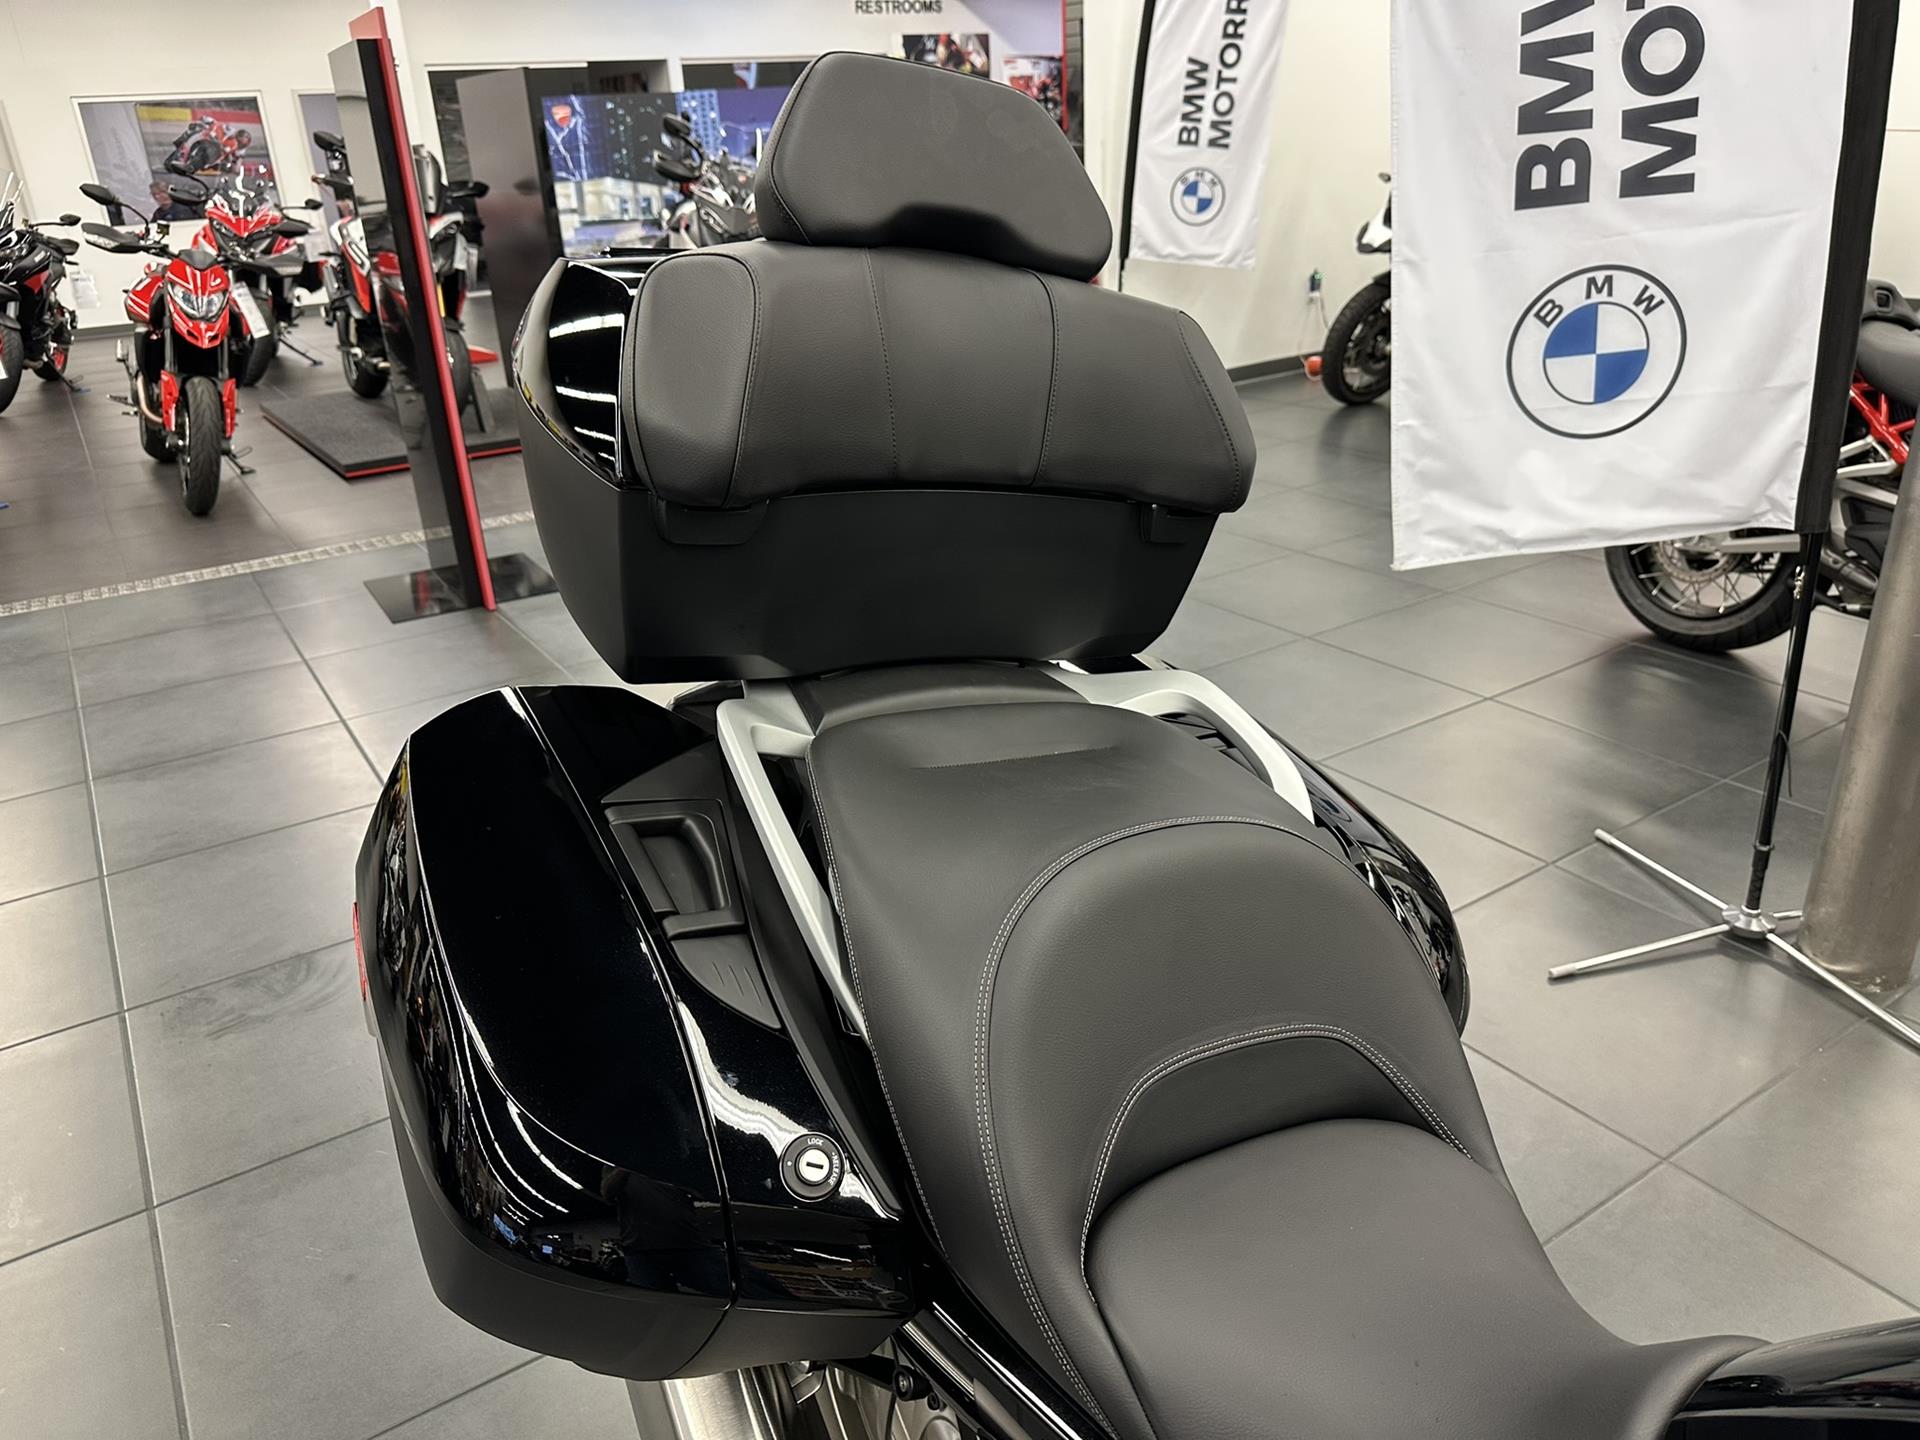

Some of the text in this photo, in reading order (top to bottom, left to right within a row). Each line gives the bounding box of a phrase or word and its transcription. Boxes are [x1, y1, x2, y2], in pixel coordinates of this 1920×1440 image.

[855, 0, 943, 14] RESTROOMS
[1178, 57, 1210, 147] BMW
[1619, 0, 1705, 198] MO
[1534, 275, 1666, 328] BMW
[807, 1137, 825, 1146] LOCK
[828, 1155, 839, 1186] RELEASE
